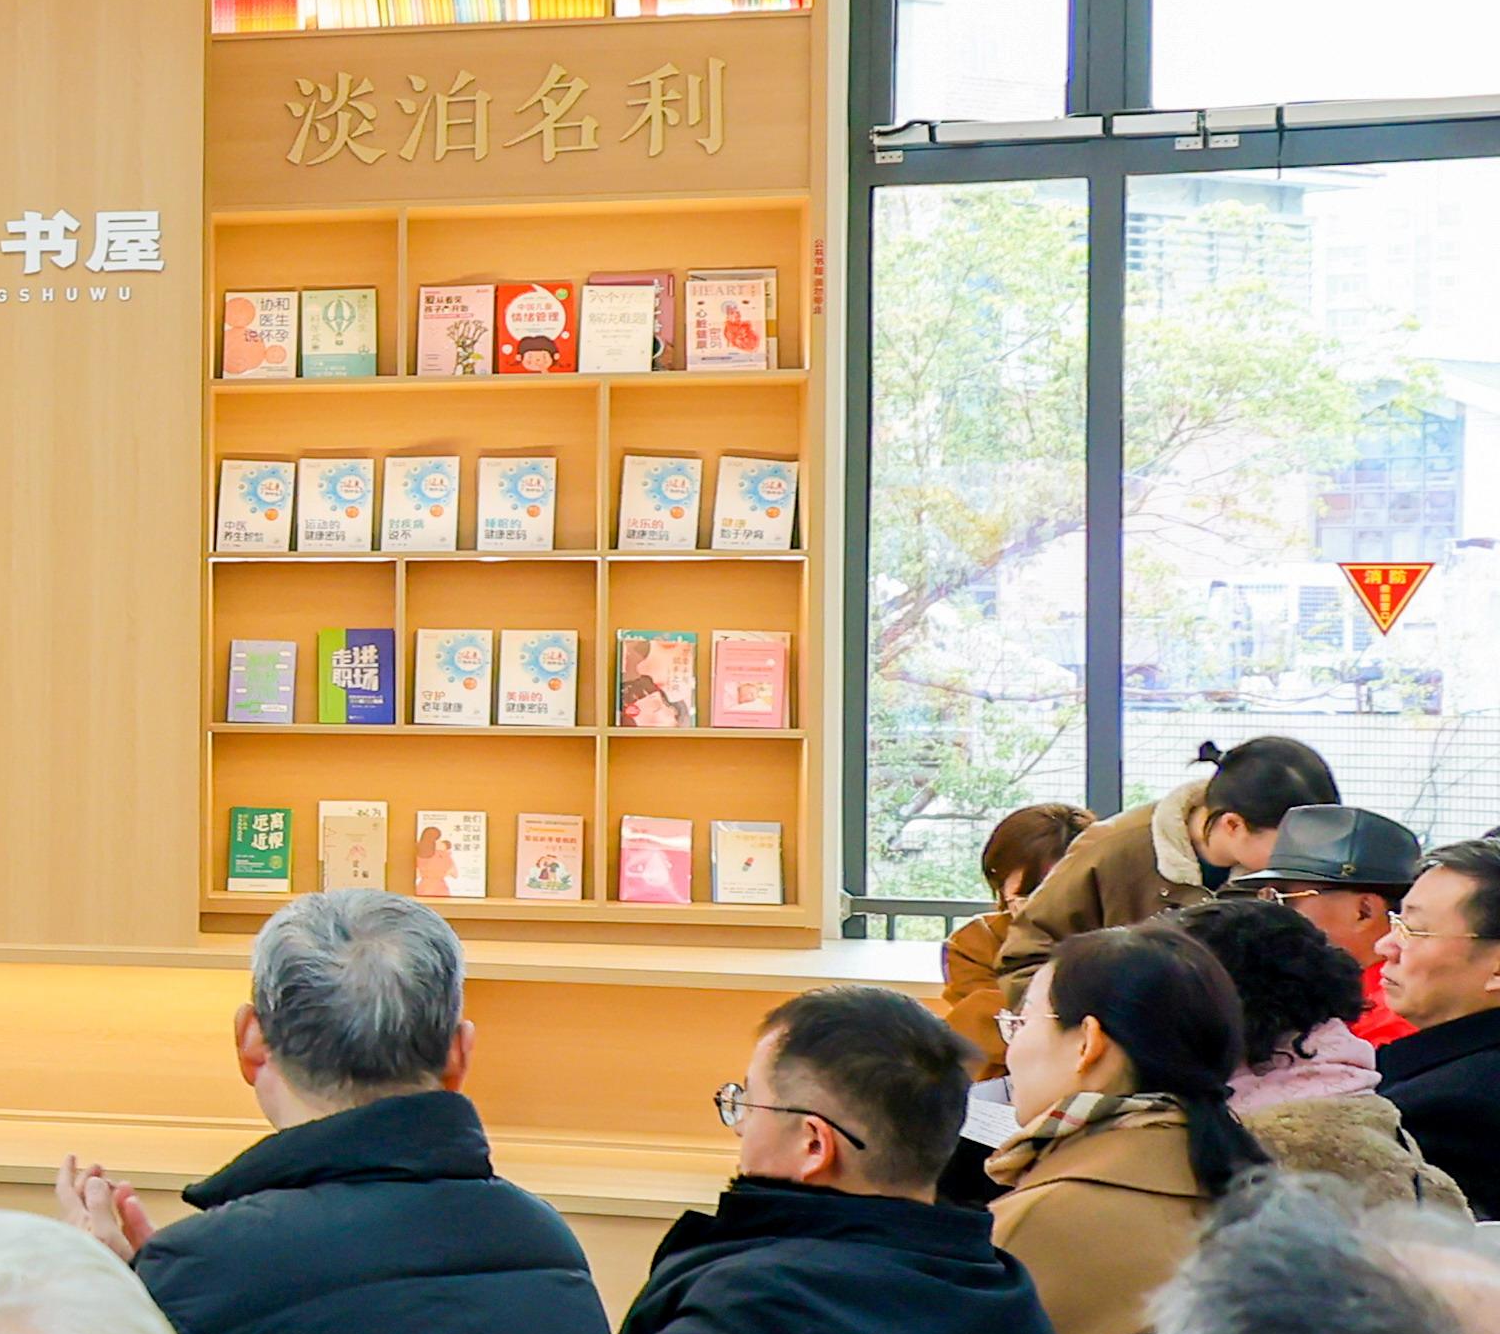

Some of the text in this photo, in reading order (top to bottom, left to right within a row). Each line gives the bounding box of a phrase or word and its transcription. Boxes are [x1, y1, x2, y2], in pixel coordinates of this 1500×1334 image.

[285, 57, 727, 165] 淡泊名利
[692, 285, 747, 297] HEART
[260, 297, 290, 311] 协和
[260, 314, 290, 327] 医生
[511, 312, 559, 323] 情绪管理
[244, 329, 289, 343] 说怀孕
[331, 644, 379, 668] 走进
[331, 667, 380, 692] 职场
